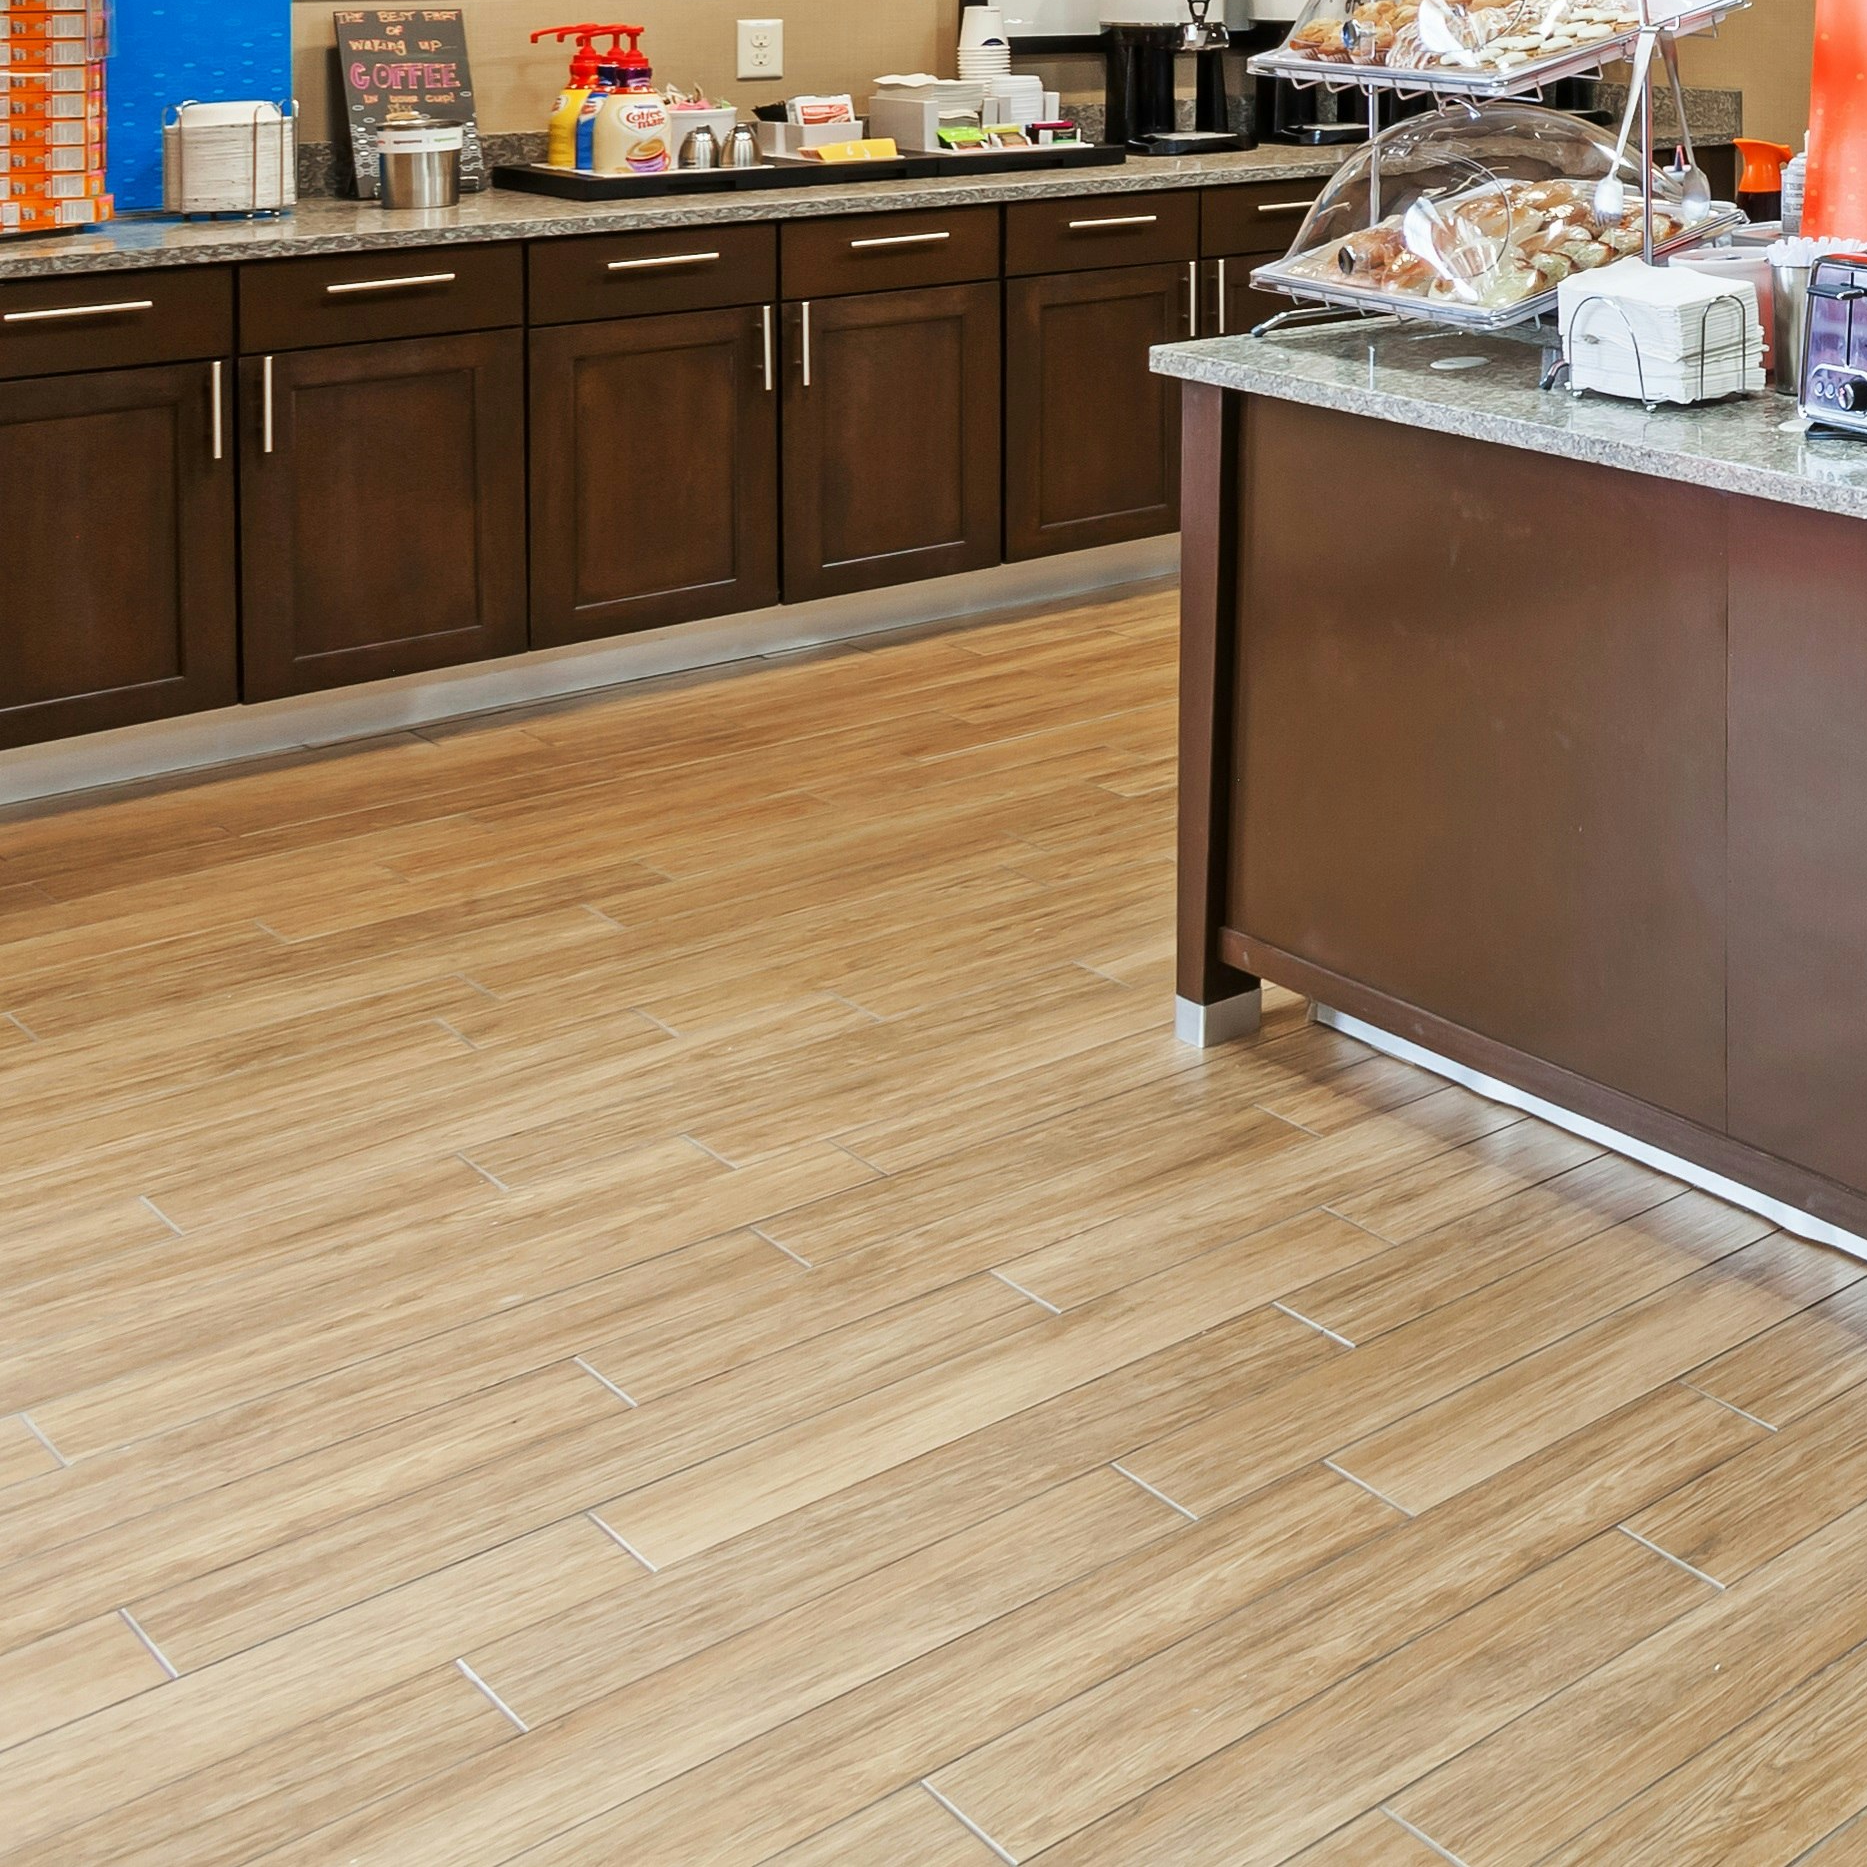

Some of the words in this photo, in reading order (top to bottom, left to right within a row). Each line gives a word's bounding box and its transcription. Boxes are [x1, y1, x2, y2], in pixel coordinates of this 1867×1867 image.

[335, 12, 365, 24] THE
[377, 11, 416, 22] BEST
[350, 62, 461, 89] COFFEE
